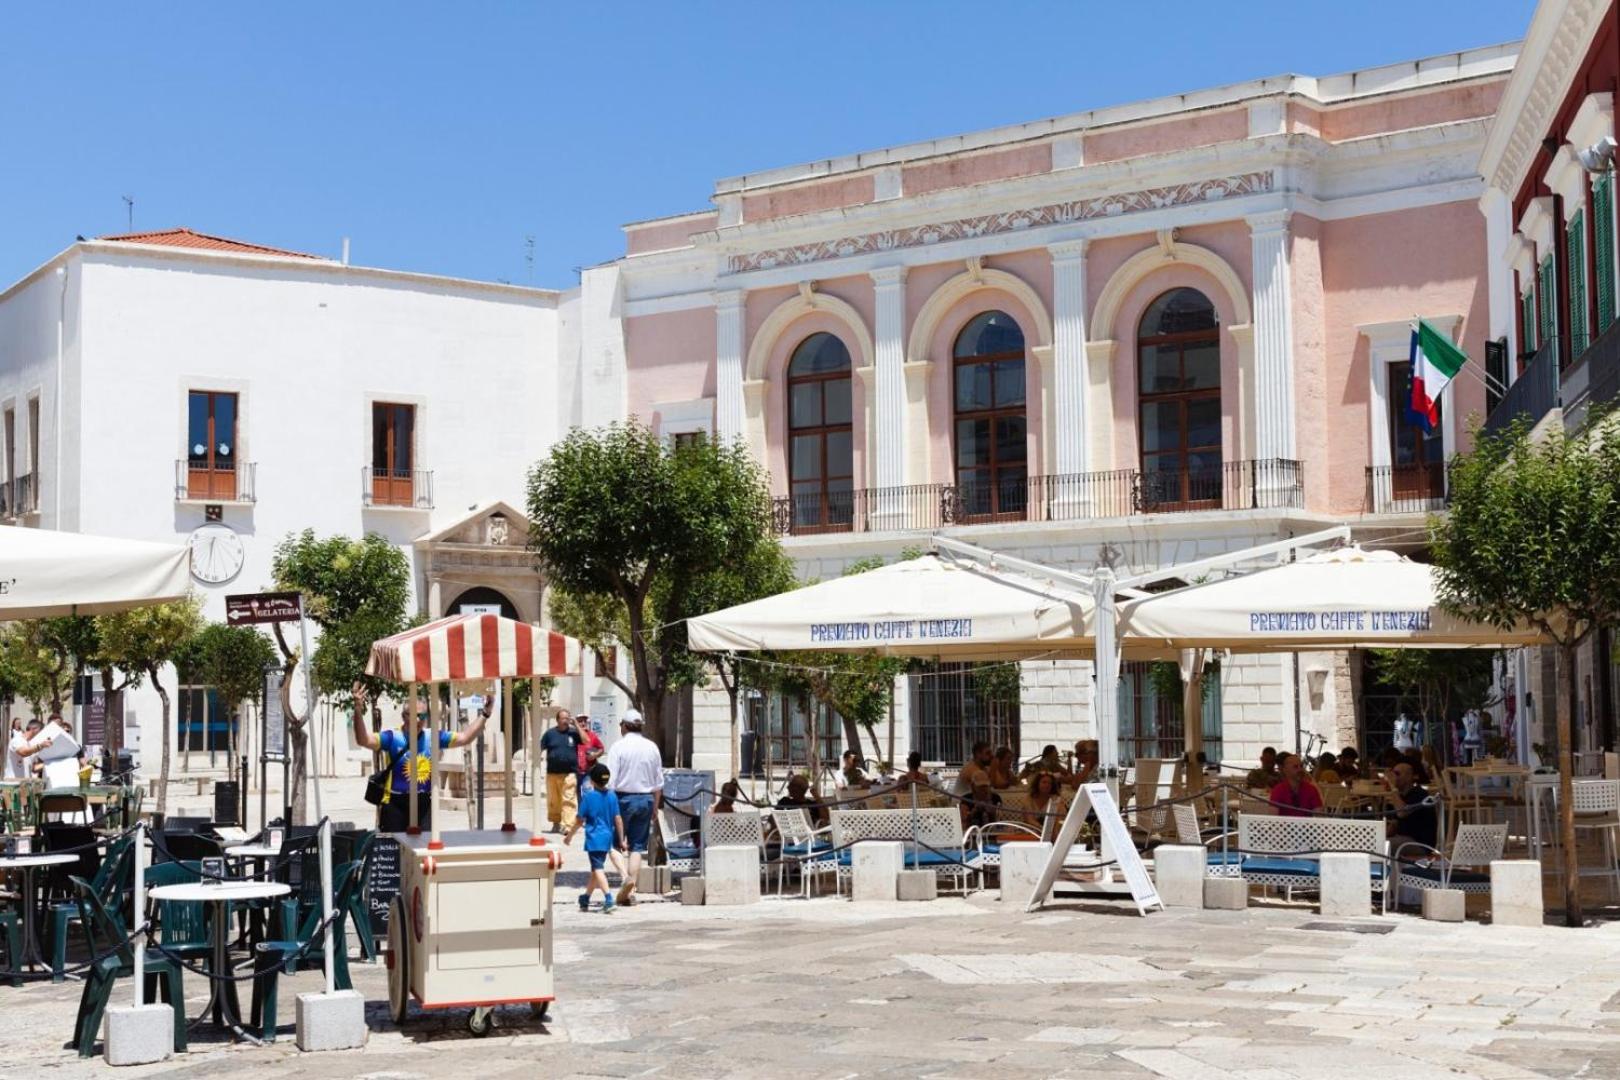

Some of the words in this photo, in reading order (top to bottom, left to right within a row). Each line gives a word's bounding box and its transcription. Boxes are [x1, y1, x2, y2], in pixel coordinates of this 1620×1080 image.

[257, 607, 300, 617] GELATERIA
[1250, 612, 1317, 632] PREMIATO
[1371, 611, 1430, 631] VENEZIA
[811, 622, 870, 642] PREMIATO
[919, 618, 972, 638] VENEZIA
